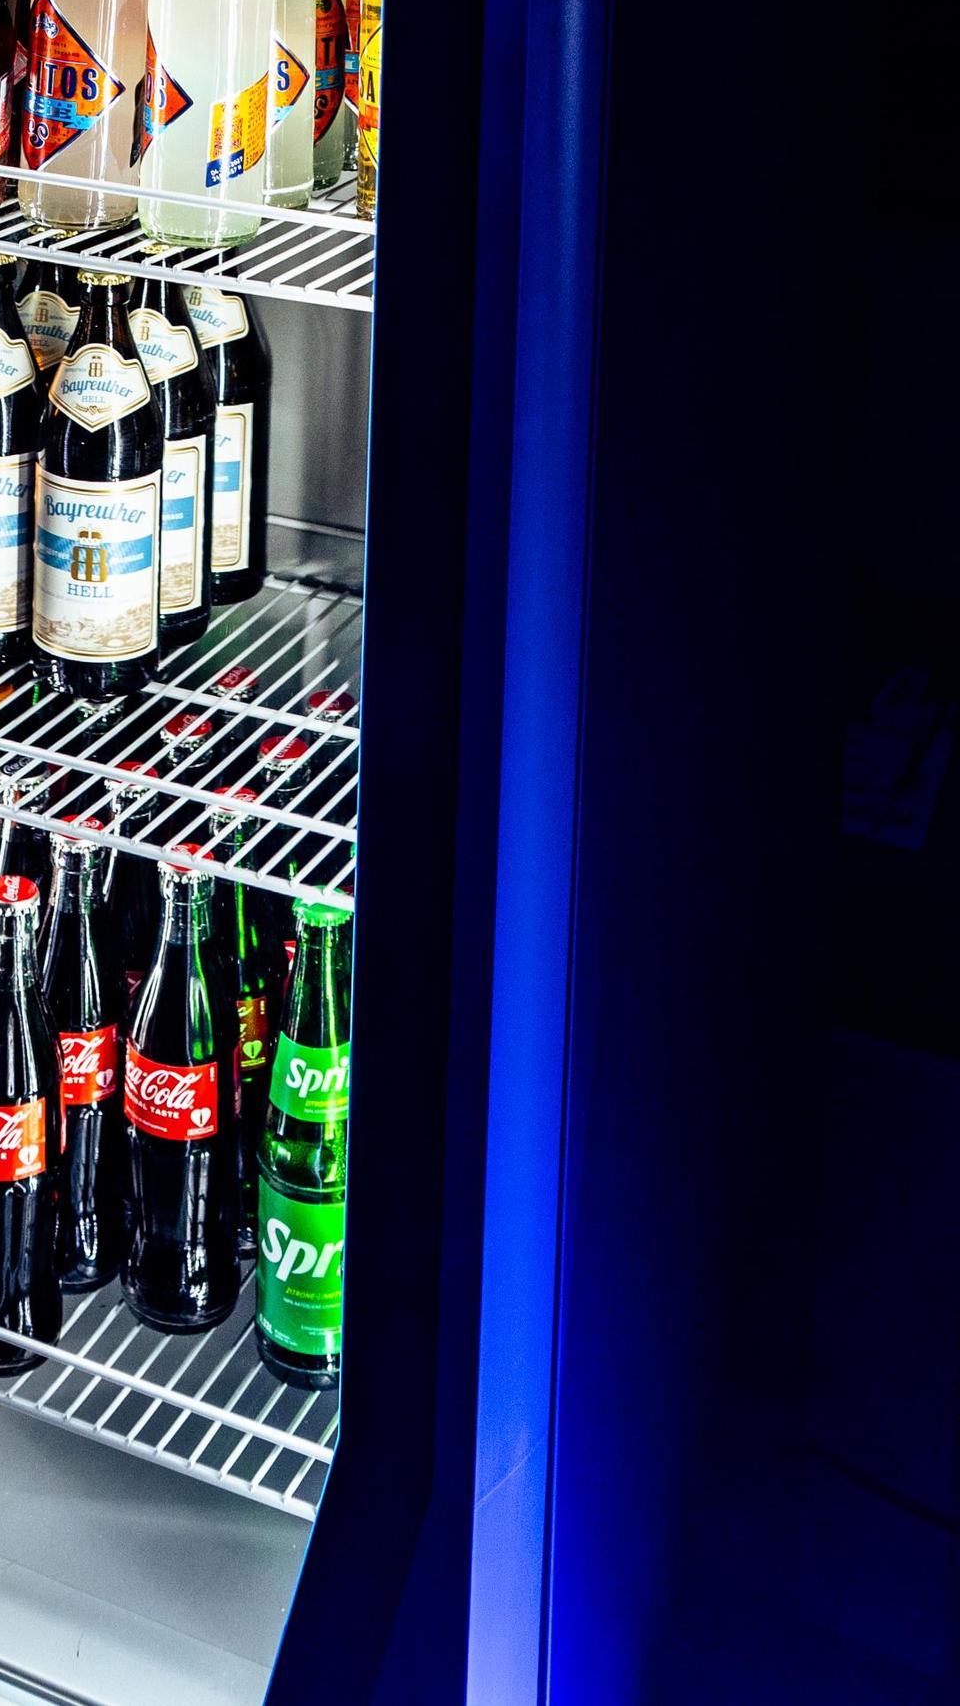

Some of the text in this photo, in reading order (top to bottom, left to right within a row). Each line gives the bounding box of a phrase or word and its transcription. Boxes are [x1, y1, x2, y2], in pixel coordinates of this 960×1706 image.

[61, 378, 134, 399] Bayreuther
[81, 394, 106, 404] HELL
[43, 493, 147, 525] Bayreuther
[66, 582, 114, 599] HELL
[150, 1105, 180, 1120] TASTE
[261, 1217, 344, 1282] Spr
